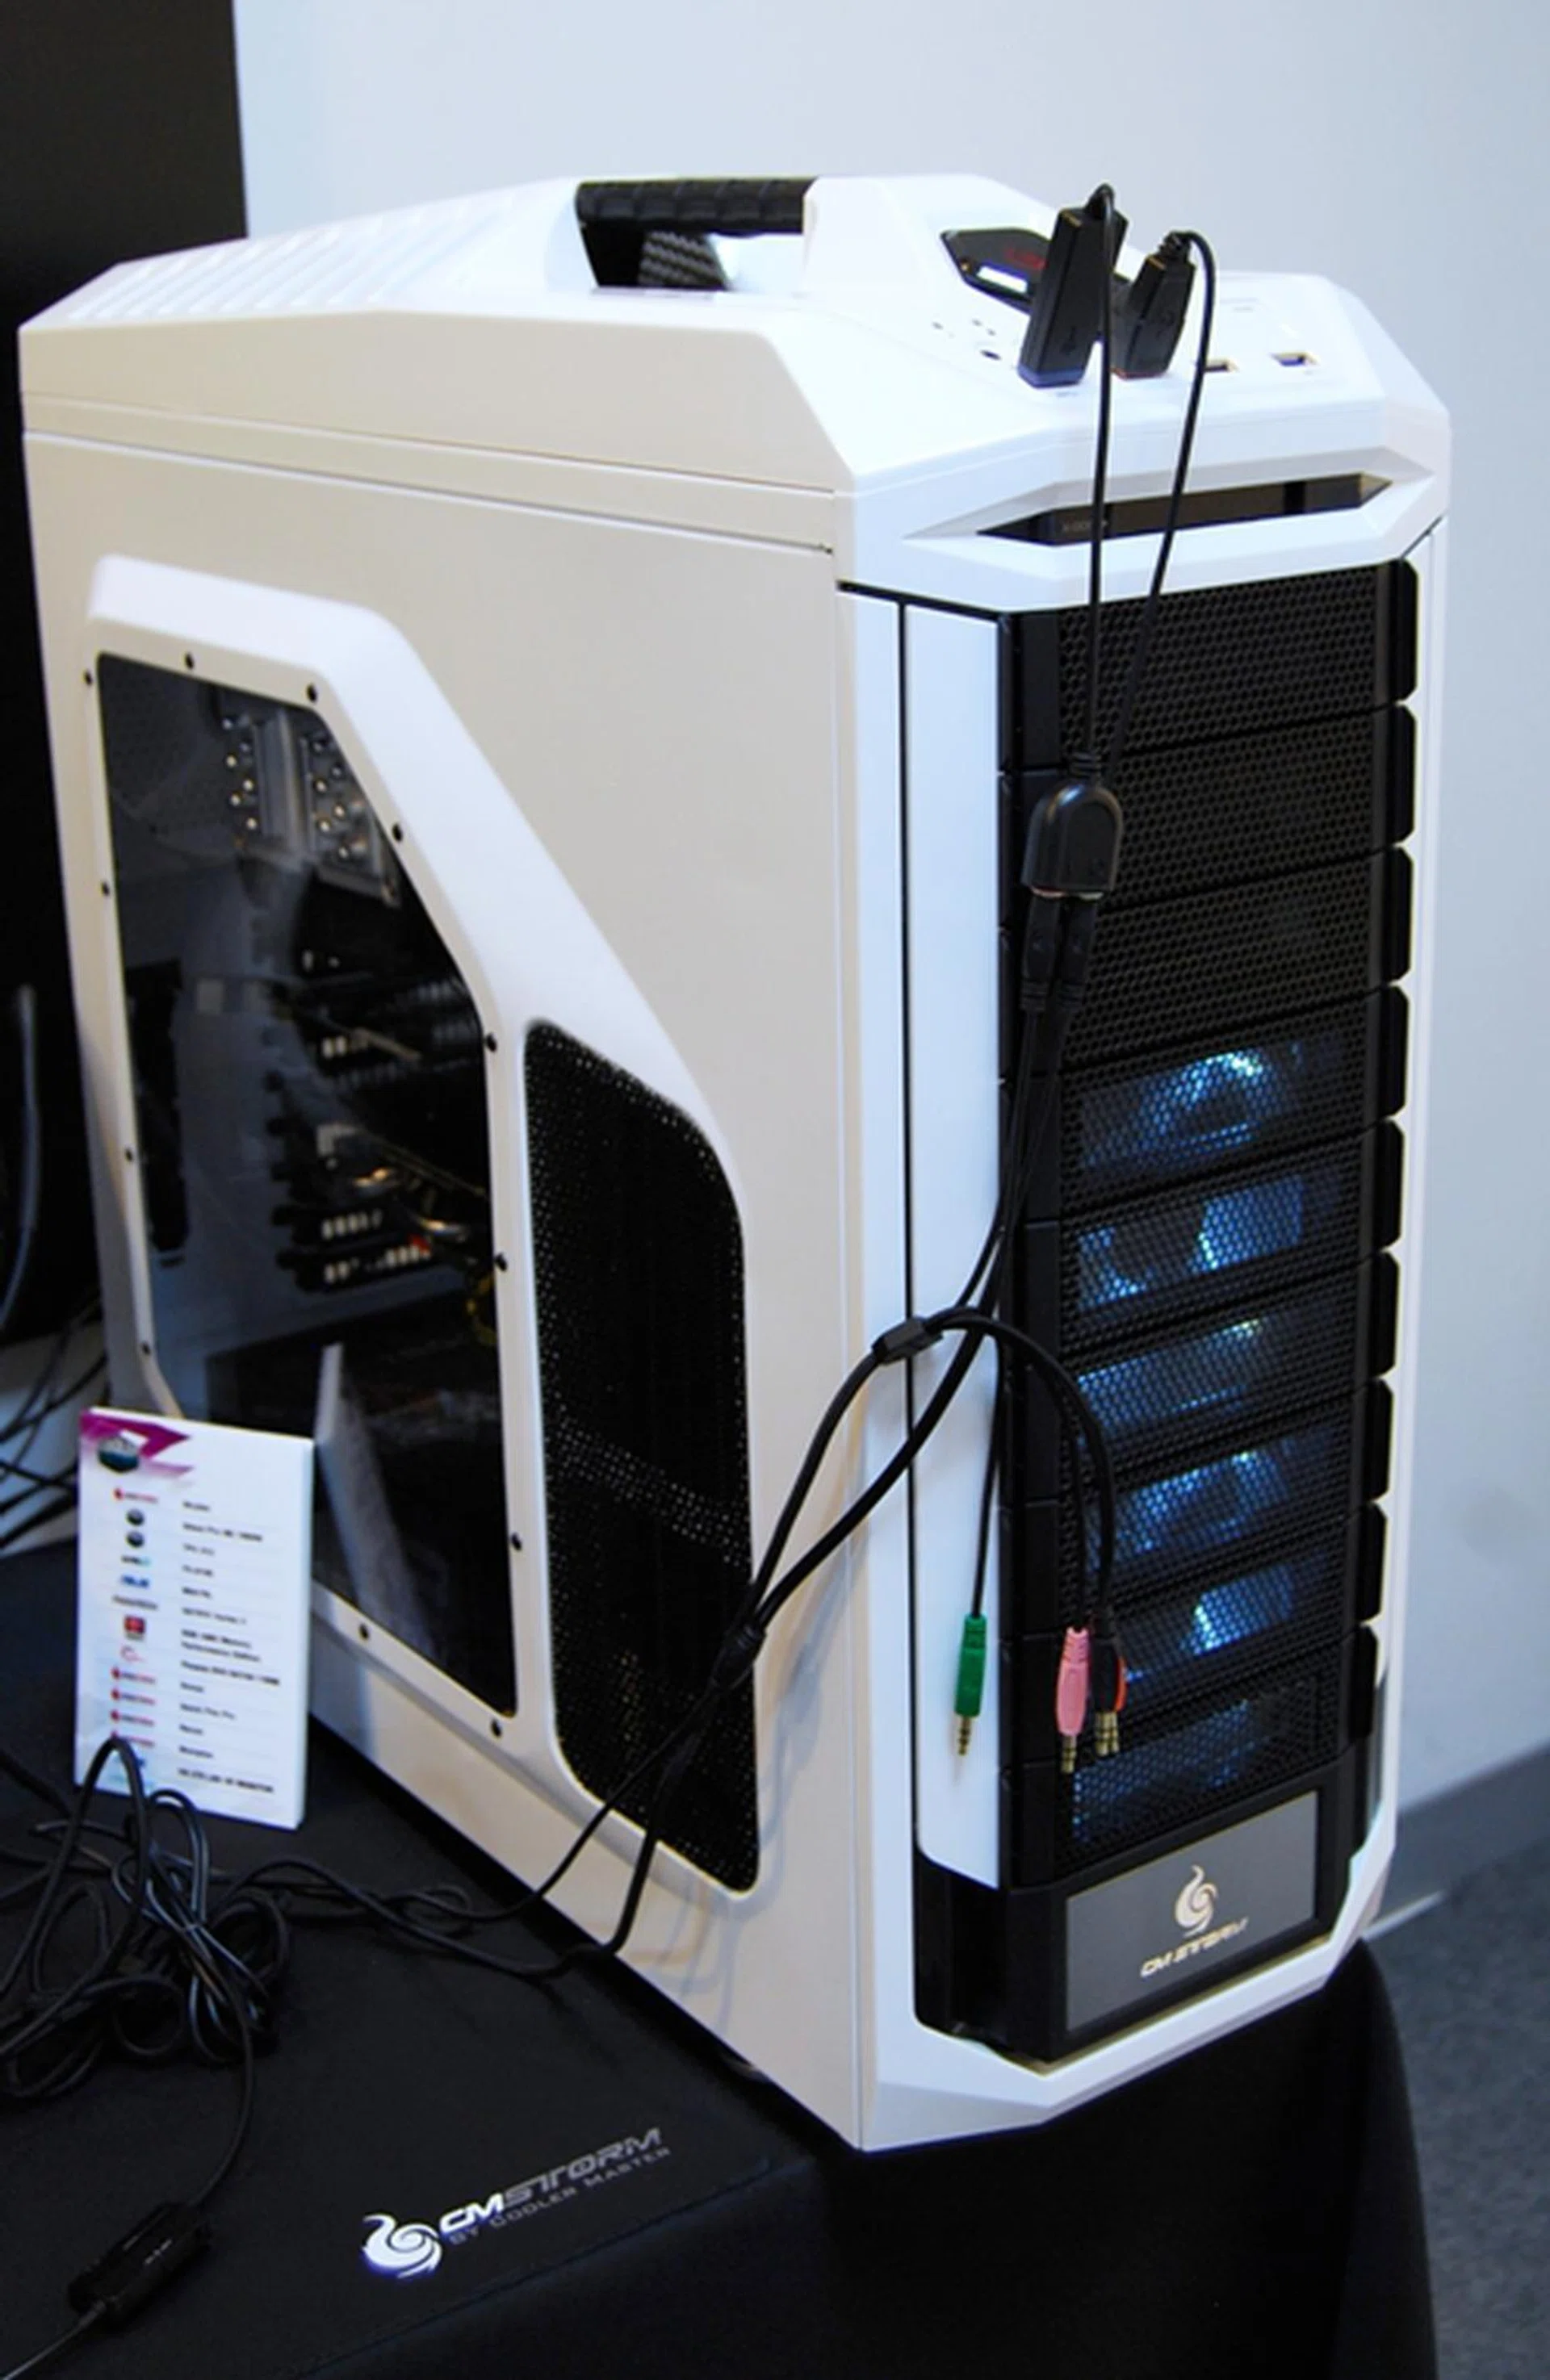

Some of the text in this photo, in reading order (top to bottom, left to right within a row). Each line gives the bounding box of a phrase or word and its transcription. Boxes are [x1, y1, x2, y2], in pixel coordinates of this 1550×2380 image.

[449, 2146, 671, 2246] BY COOLER MASTER
